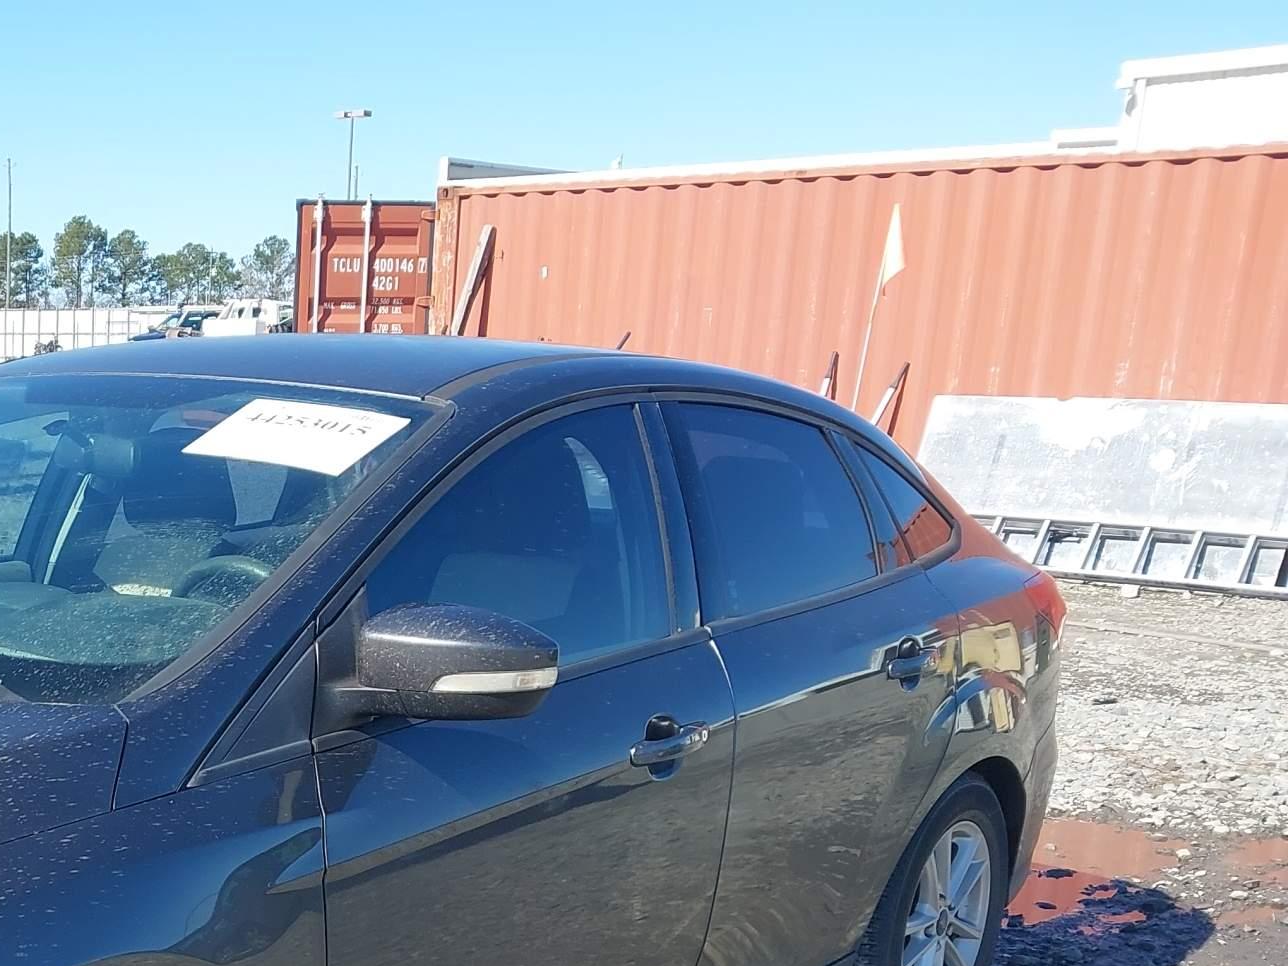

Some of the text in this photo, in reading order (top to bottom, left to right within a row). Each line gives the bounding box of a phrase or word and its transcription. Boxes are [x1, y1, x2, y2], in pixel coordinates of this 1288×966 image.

[332, 257, 361, 273] TCLU
[372, 257, 414, 273] 400146
[372, 276, 399, 291] 42G1
[246, 412, 372, 436] 44253015
